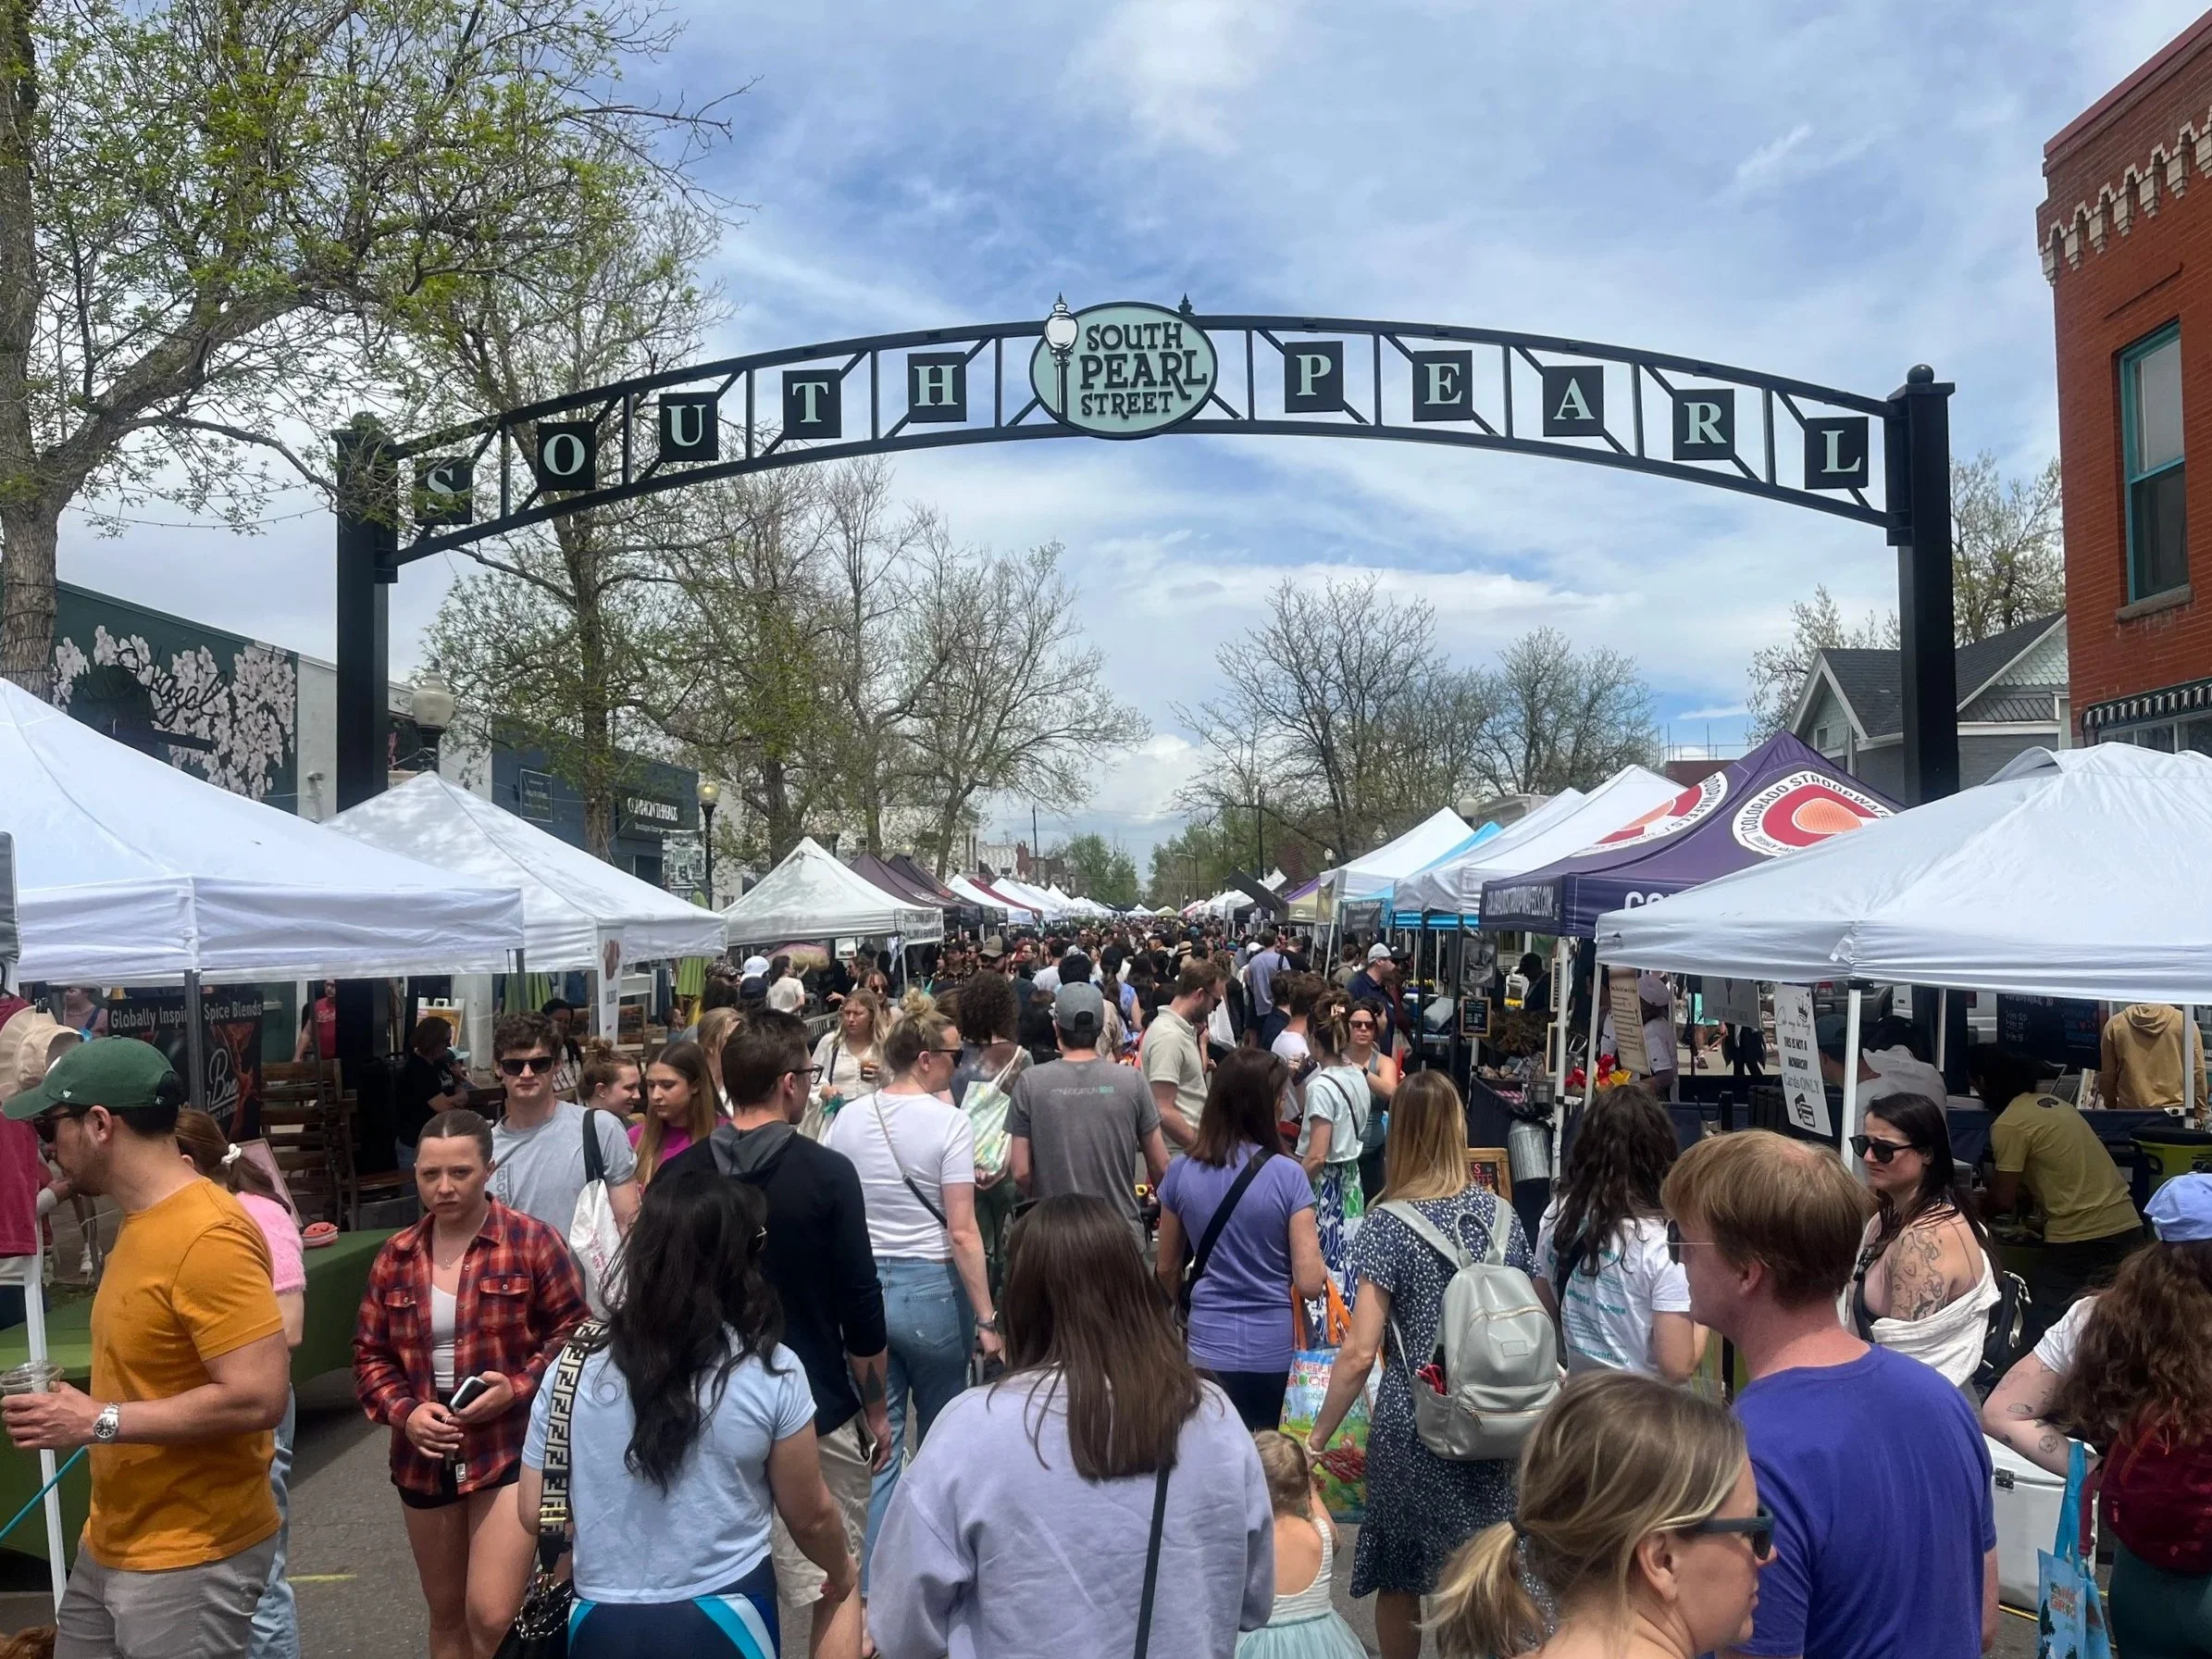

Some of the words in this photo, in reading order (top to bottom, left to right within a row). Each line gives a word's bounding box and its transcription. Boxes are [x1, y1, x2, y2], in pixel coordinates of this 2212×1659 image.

[1086, 322, 1183, 351] SOUTH
[1080, 350, 1207, 400] PEARL
[1081, 392, 1173, 419] STREET
[1741, 783, 1790, 832] COLORADO
[111, 1007, 156, 1032] Globally
[159, 1005, 188, 1029] Inspi
[204, 1003, 230, 1024] Spice
[232, 999, 263, 1018] Blends
[1783, 1036, 1792, 1048] THIS
[1783, 1072, 1800, 1089] Cards
[1800, 1077, 1820, 1093] ONLY
